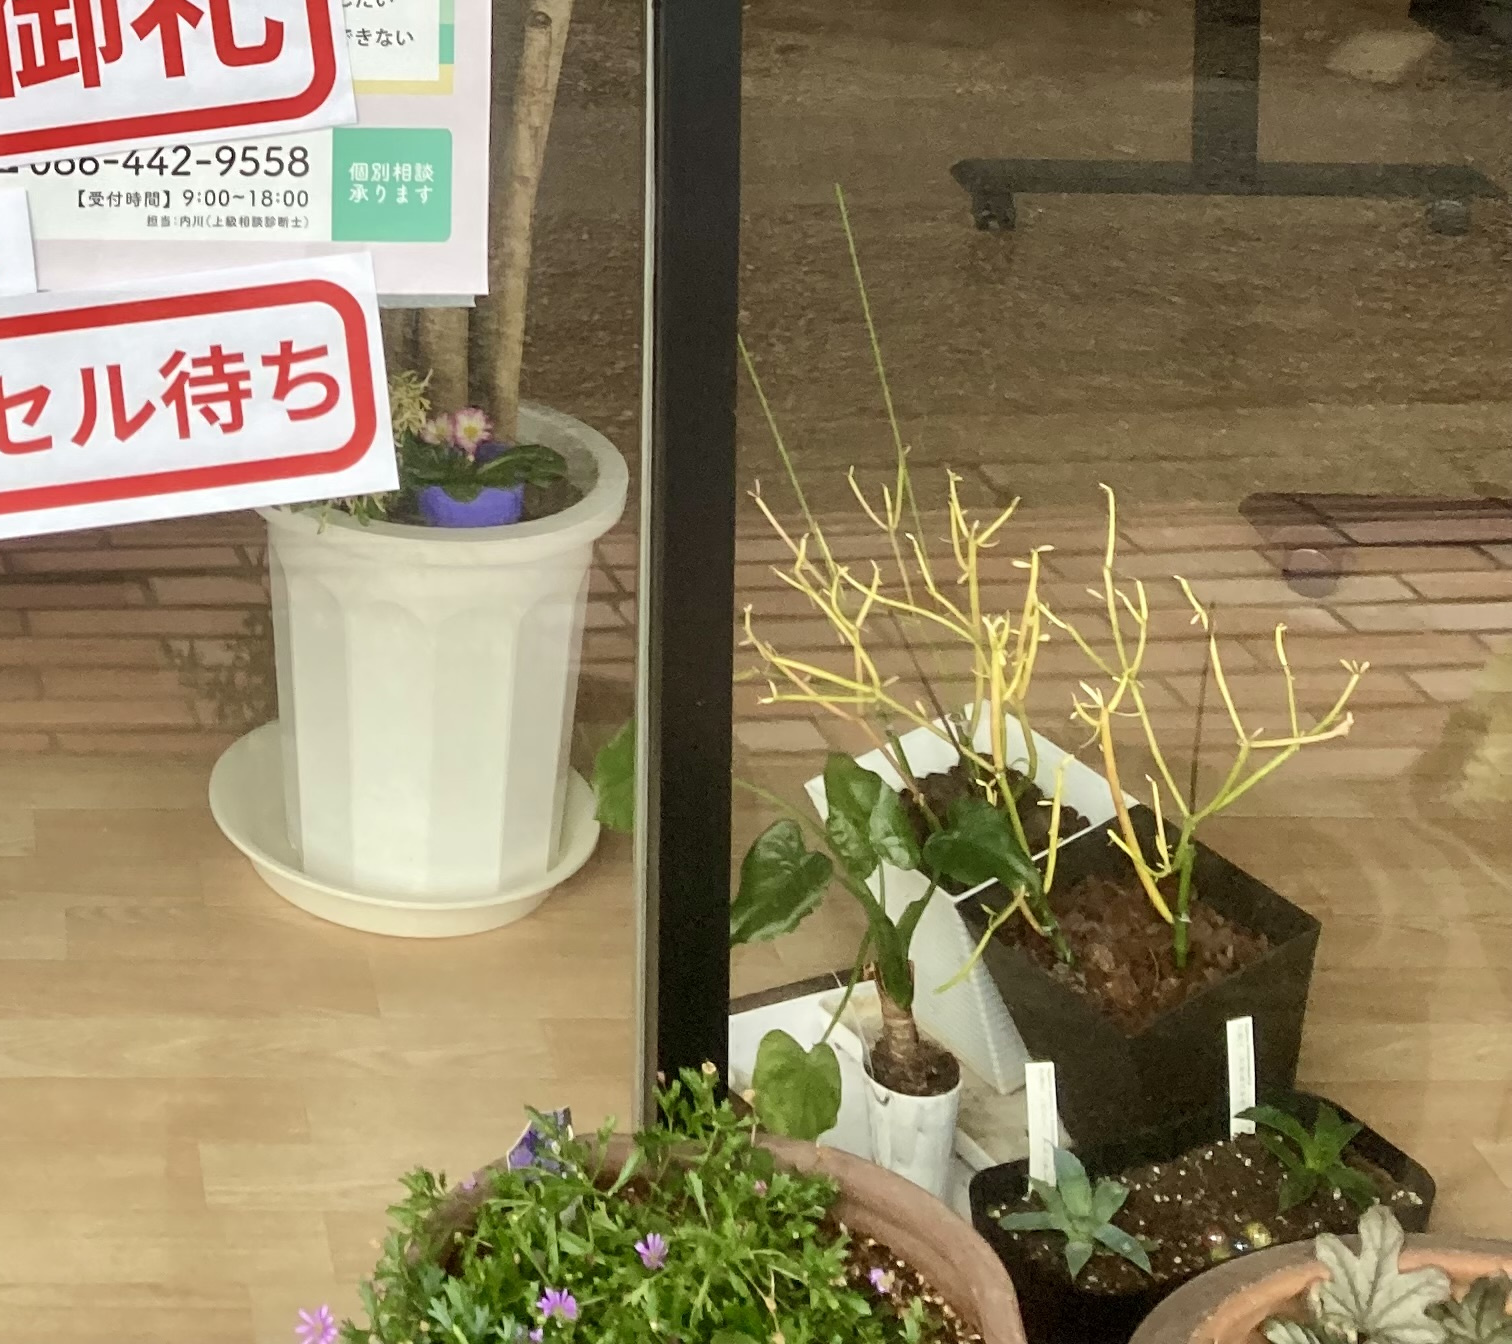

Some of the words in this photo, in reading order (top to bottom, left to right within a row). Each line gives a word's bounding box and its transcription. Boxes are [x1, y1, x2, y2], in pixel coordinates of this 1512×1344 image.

[345, 27, 415, 47] きない
[349, 162, 435, 182] 個別相談
[77, 188, 171, 208] 【受付時間】
[349, 184, 434, 204] 承ります
